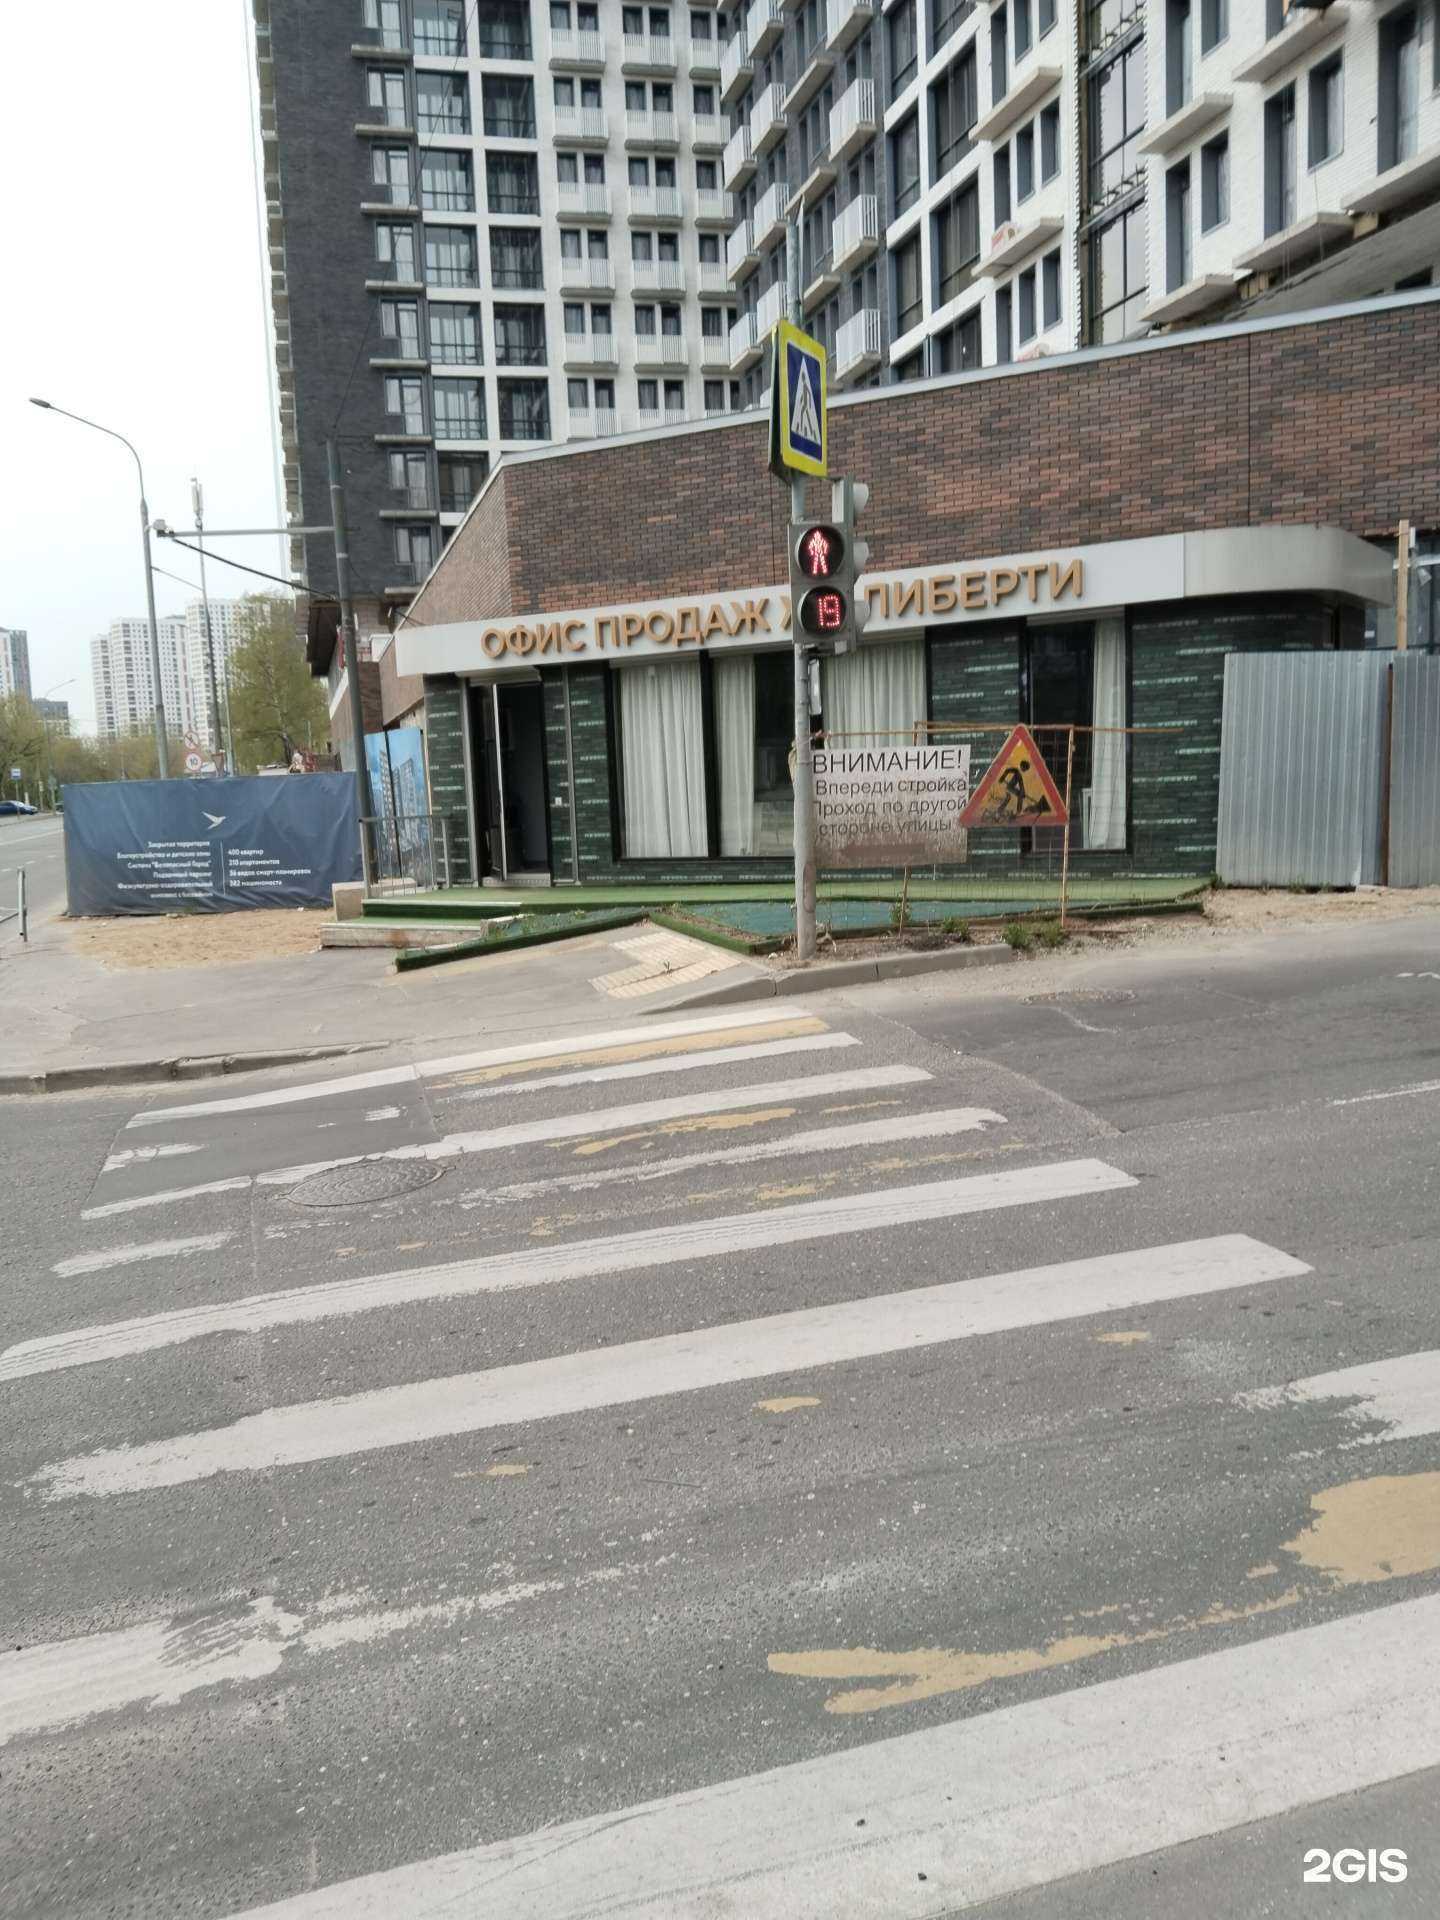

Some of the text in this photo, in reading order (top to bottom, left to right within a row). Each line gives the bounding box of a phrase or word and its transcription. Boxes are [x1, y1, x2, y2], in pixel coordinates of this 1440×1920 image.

[480, 617, 586, 660] ОФИС
[593, 594, 773, 648] ПРОДАЖ
[863, 558, 1086, 620] ЛИБЕРТИ
[816, 592, 841, 629] 19
[812, 749, 962, 775] ВНИМАНИЕ!
[815, 774, 967, 799] Впереди стройка
[882, 801, 903, 815] по
[908, 795, 967, 817] другой
[818, 819, 893, 839] стороне
